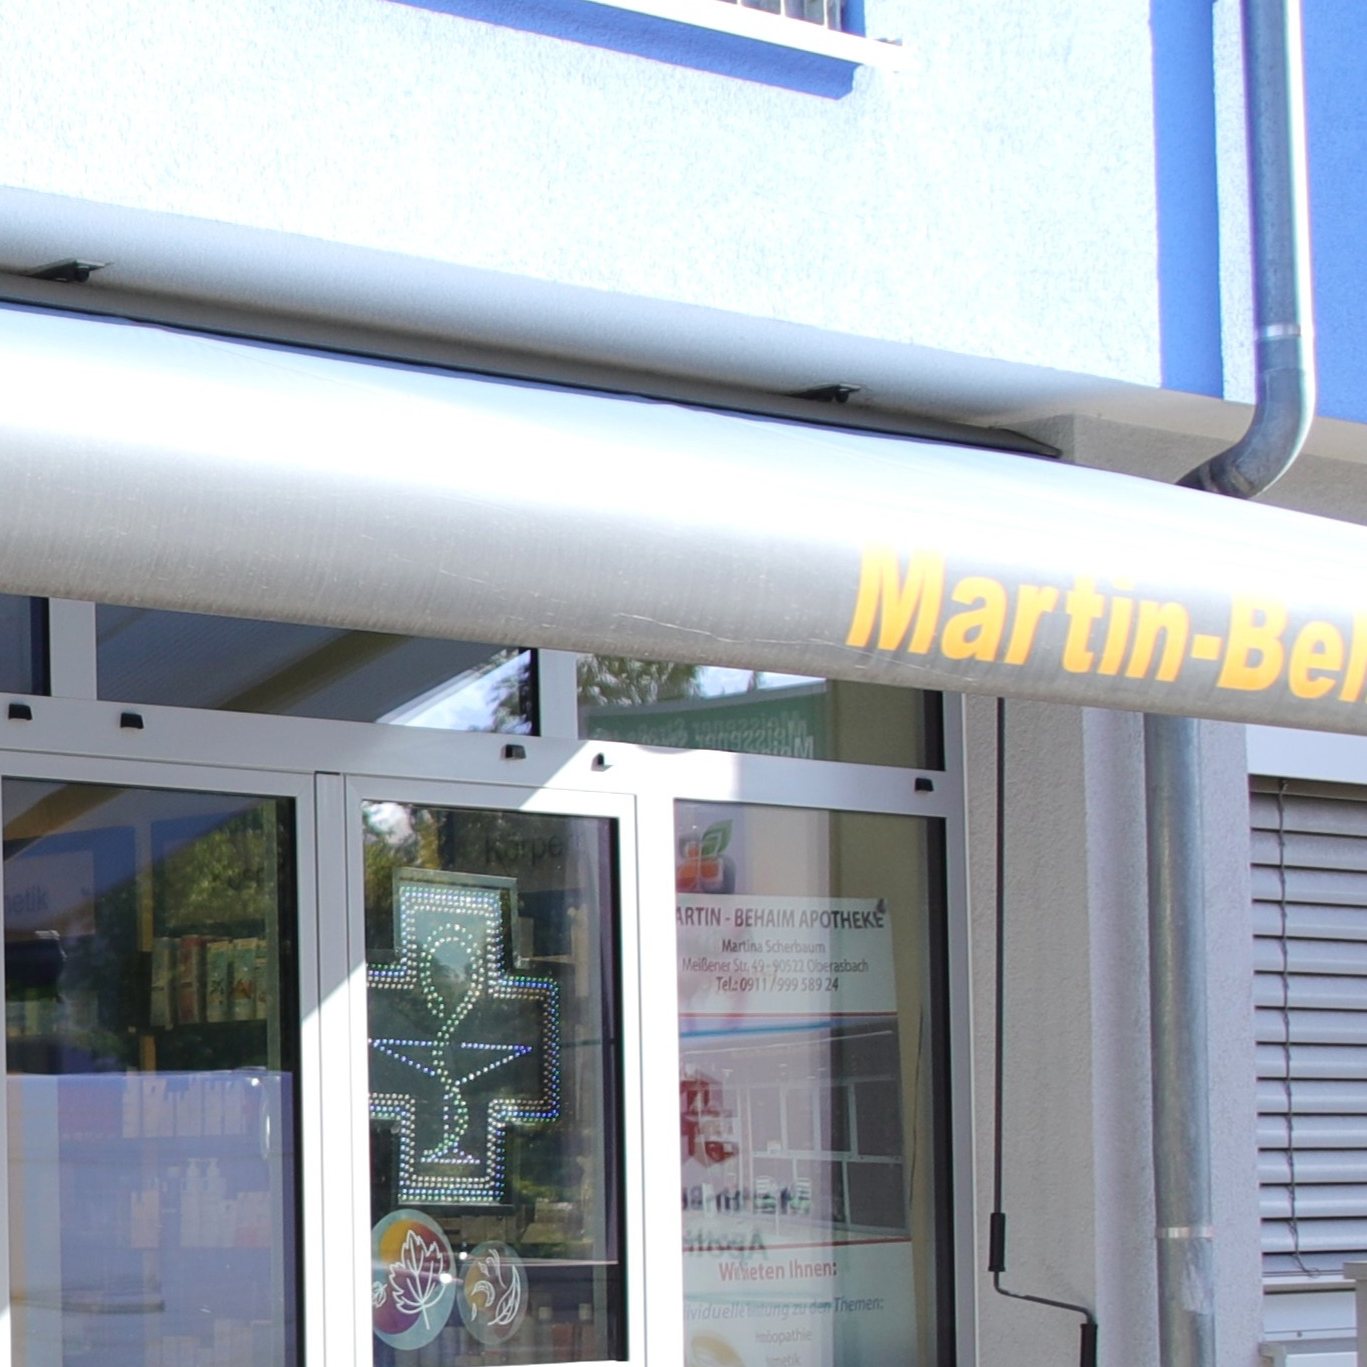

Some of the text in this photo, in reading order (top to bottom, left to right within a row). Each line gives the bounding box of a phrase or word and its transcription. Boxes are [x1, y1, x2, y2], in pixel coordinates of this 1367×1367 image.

[676, 907, 721, 926] ARTIN
[734, 908, 795, 928] BEHAIM
[799, 909, 884, 929] APOTHEKE
[722, 939, 826, 953] Martina Scherbaum
[682, 958, 730, 971] Meißener
[733, 958, 750, 972] Str.
[752, 960, 764, 972] 49
[773, 960, 805, 972] 90522
[807, 958, 868, 972] Oberasbach
[740, 977, 767, 991] 0911
[778, 977, 800, 992] 999
[802, 977, 822, 992] 589
[825, 977, 839, 991] 24
[789, 1259, 837, 1279] Ihnen:
[834, 1296, 884, 1312] Themen:
